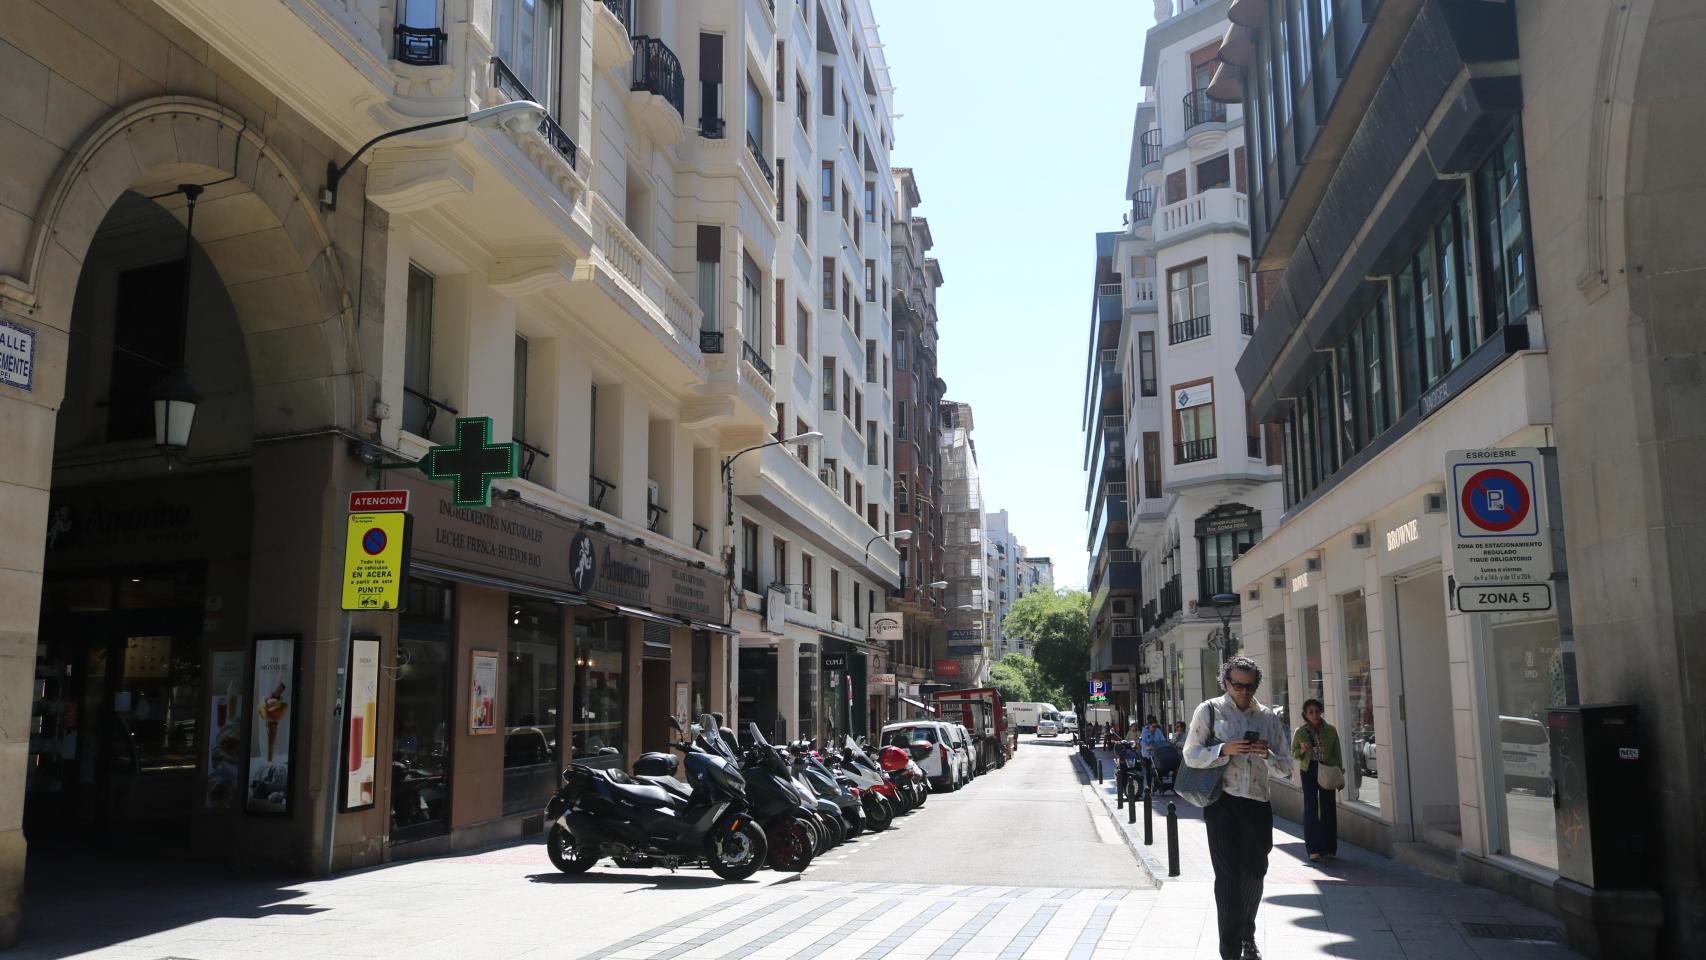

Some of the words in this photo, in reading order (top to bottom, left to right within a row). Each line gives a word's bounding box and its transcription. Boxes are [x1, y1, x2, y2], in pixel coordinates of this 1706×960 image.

[354, 496, 403, 506] ATENCION
[500, 520, 543, 544] NATURALES
[1386, 519, 1418, 552] BROWNIE
[436, 528, 466, 548] LECHE
[528, 553, 542, 568] BIO
[1478, 593, 1518, 604] ZONA
[1522, 592, 1530, 603] 5
